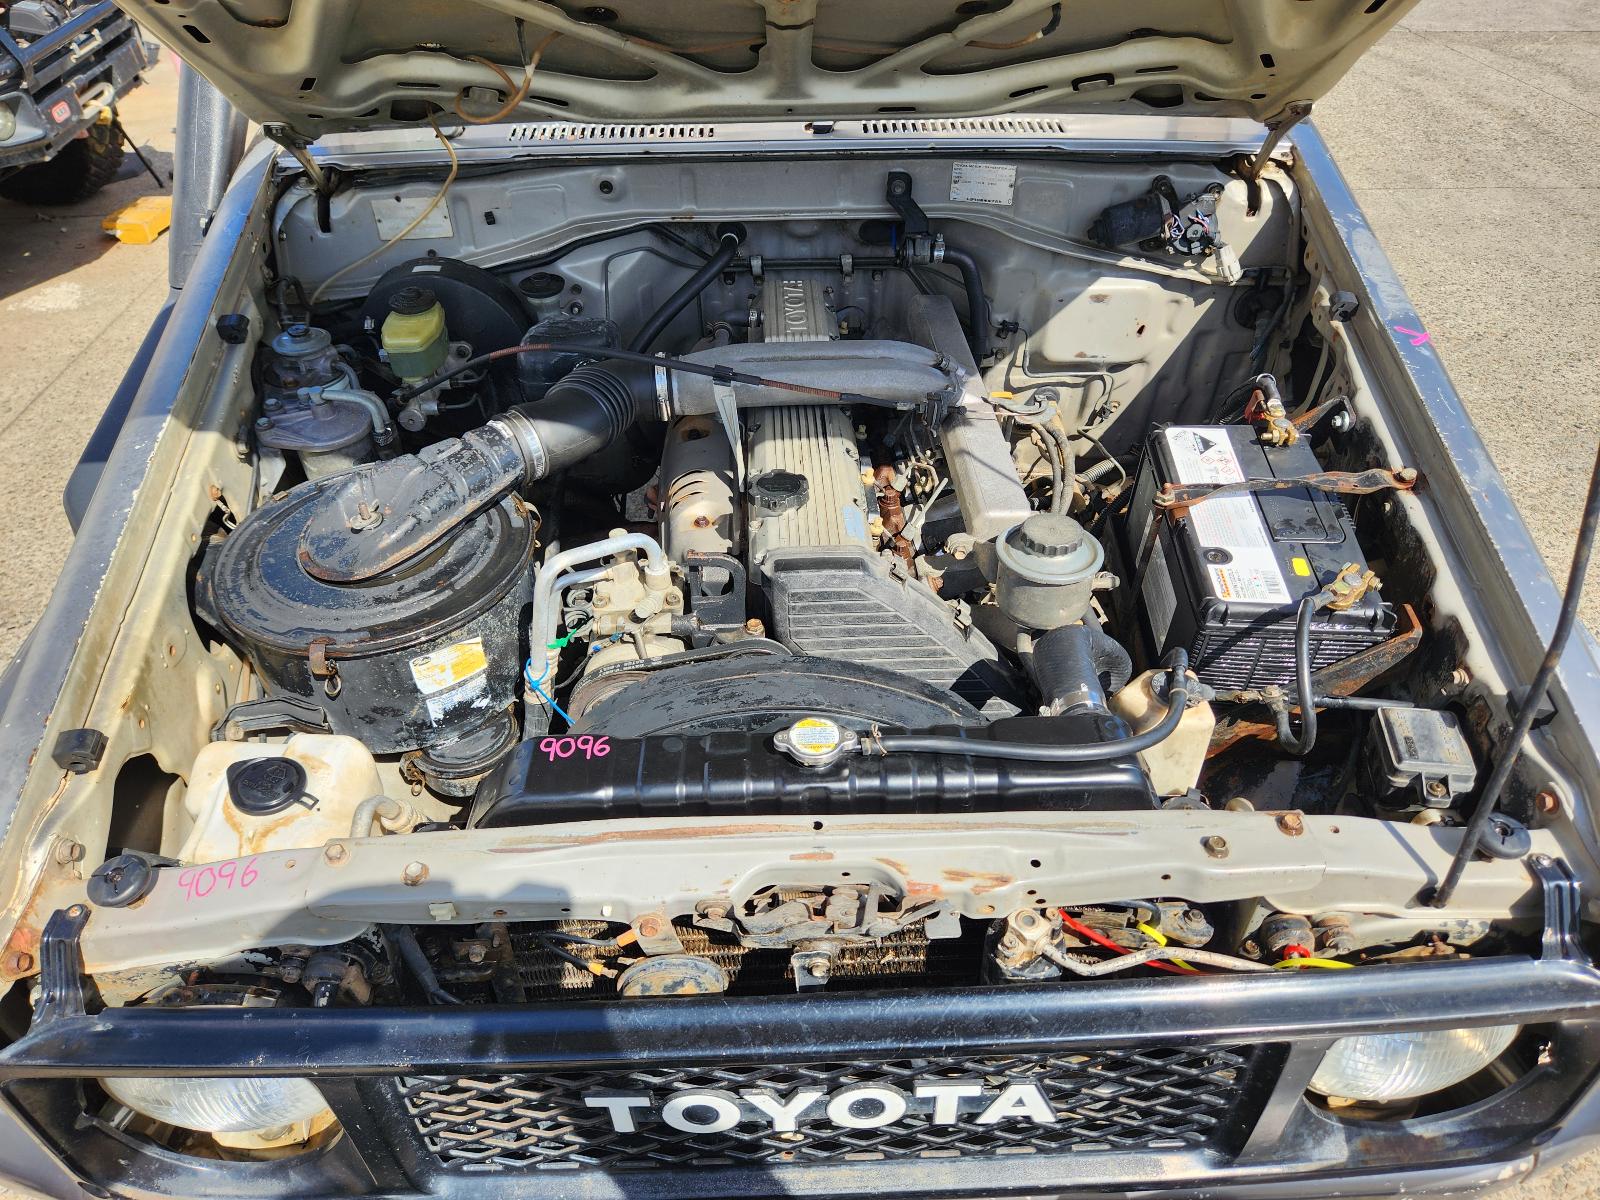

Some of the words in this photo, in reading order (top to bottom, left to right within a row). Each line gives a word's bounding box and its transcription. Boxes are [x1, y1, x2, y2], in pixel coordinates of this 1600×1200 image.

[783, 280, 807, 333] TOYOTA
[540, 735, 611, 762] 9096
[177, 857, 259, 902] 9096
[584, 1079, 1058, 1134] TOYOTA
